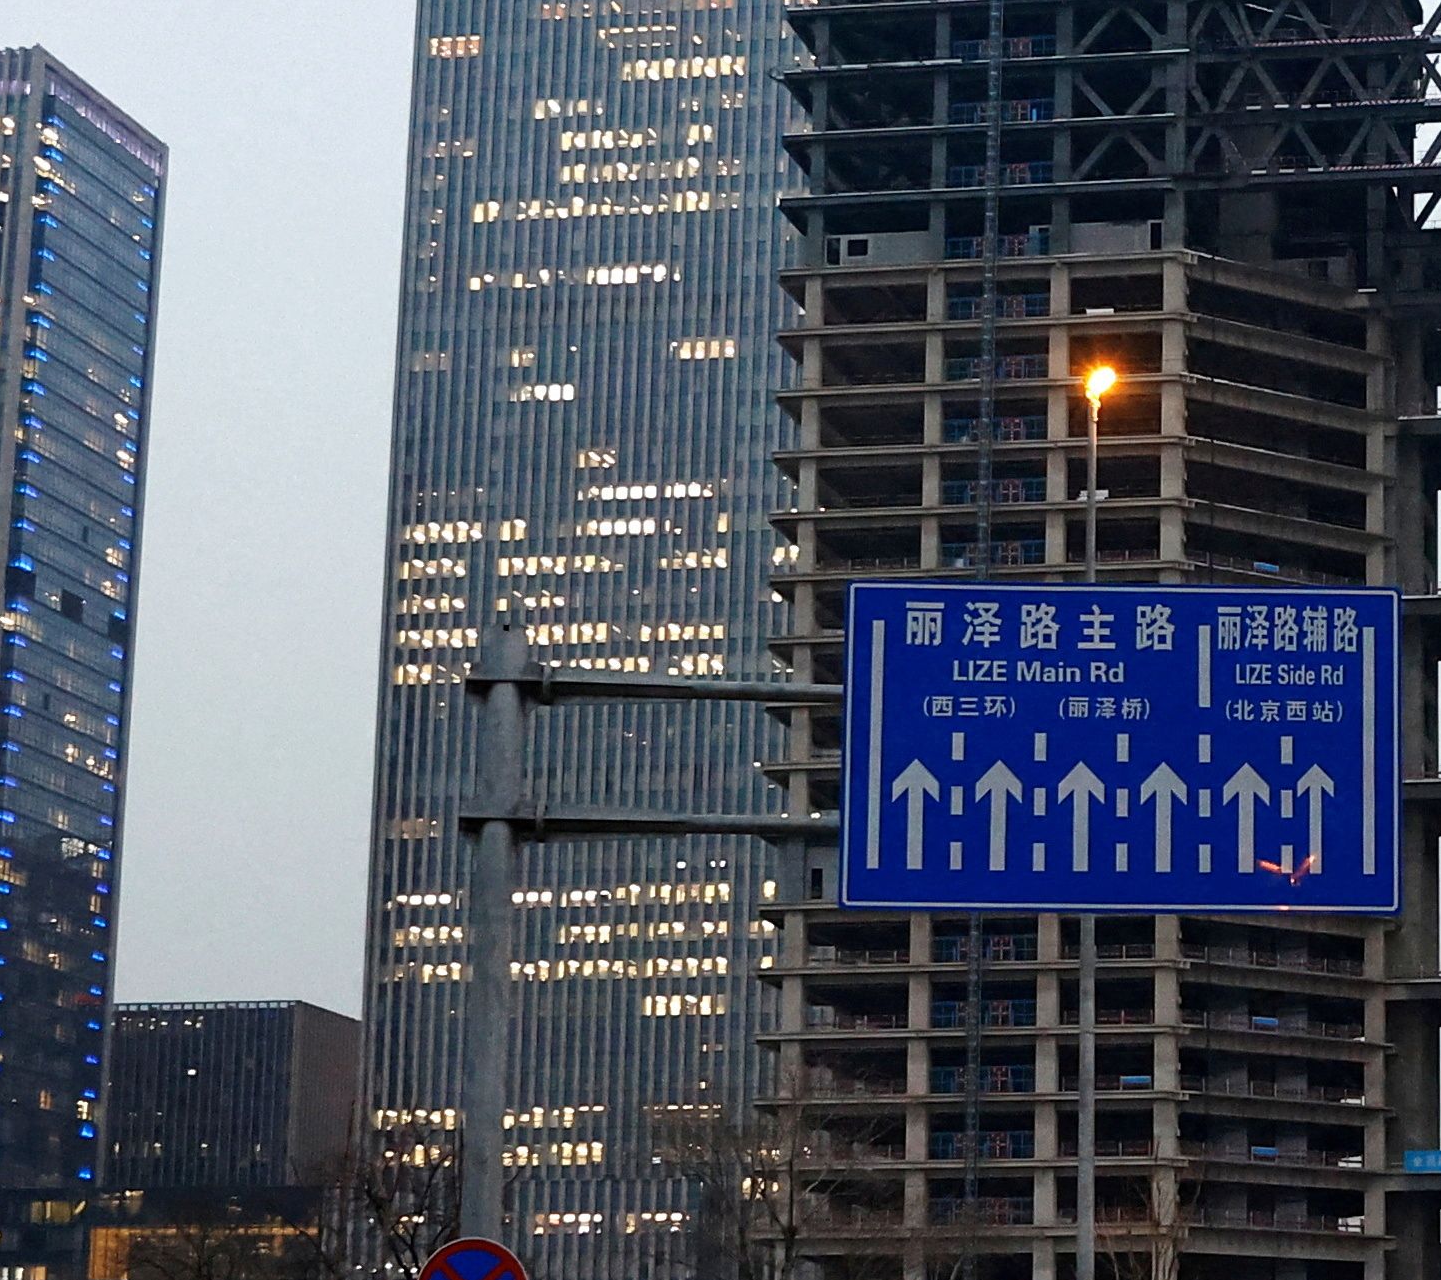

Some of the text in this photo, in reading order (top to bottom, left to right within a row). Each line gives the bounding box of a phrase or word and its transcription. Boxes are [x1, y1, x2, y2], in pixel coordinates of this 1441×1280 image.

[905, 601, 1175, 650] 丽泽路主路
[1217, 605, 1359, 653] 丽泽路辅路
[952, 660, 1125, 683] LIZE Main Rd
[1235, 664, 1344, 685] LIZE Side Rd
[1225, 699, 1343, 722] (北京西站)
